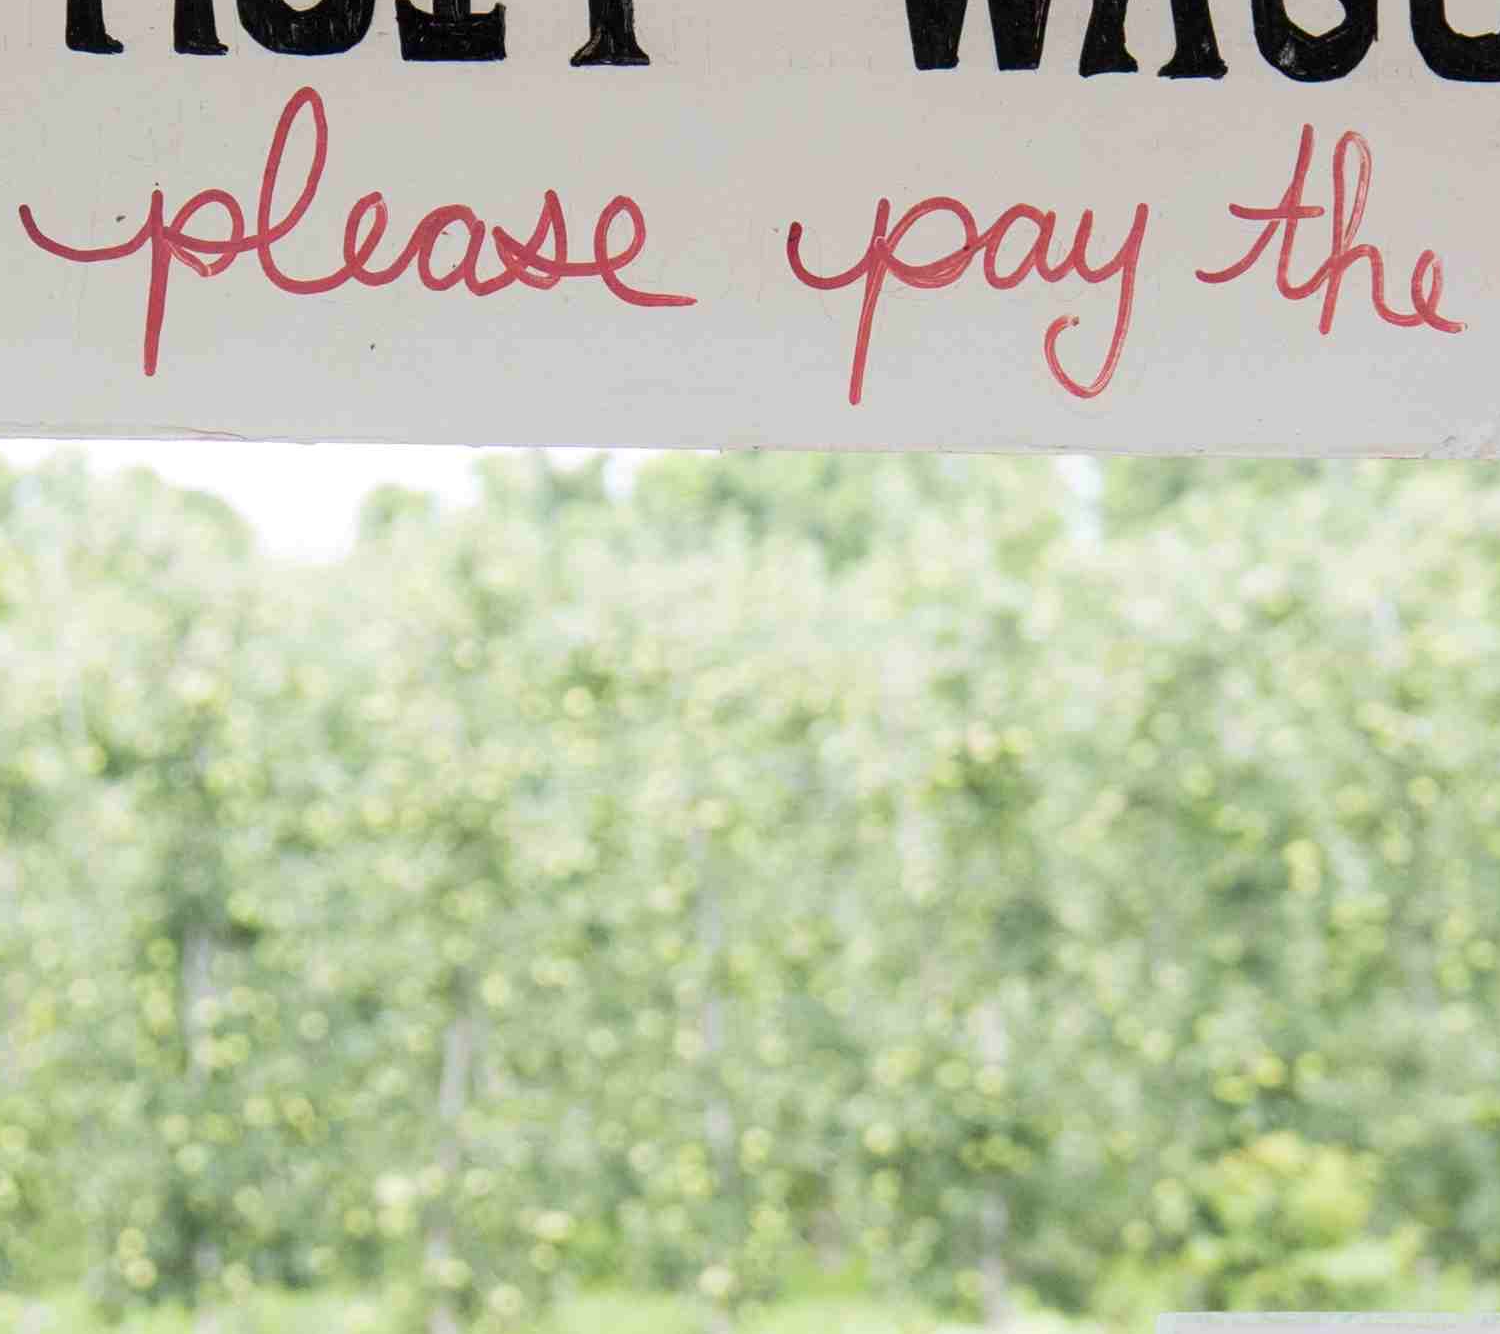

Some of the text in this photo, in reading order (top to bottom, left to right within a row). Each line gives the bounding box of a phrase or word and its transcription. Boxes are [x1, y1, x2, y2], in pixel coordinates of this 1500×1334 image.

[19, 87, 698, 376] please
[785, 195, 1150, 406] pay
[1195, 123, 1470, 335] the
